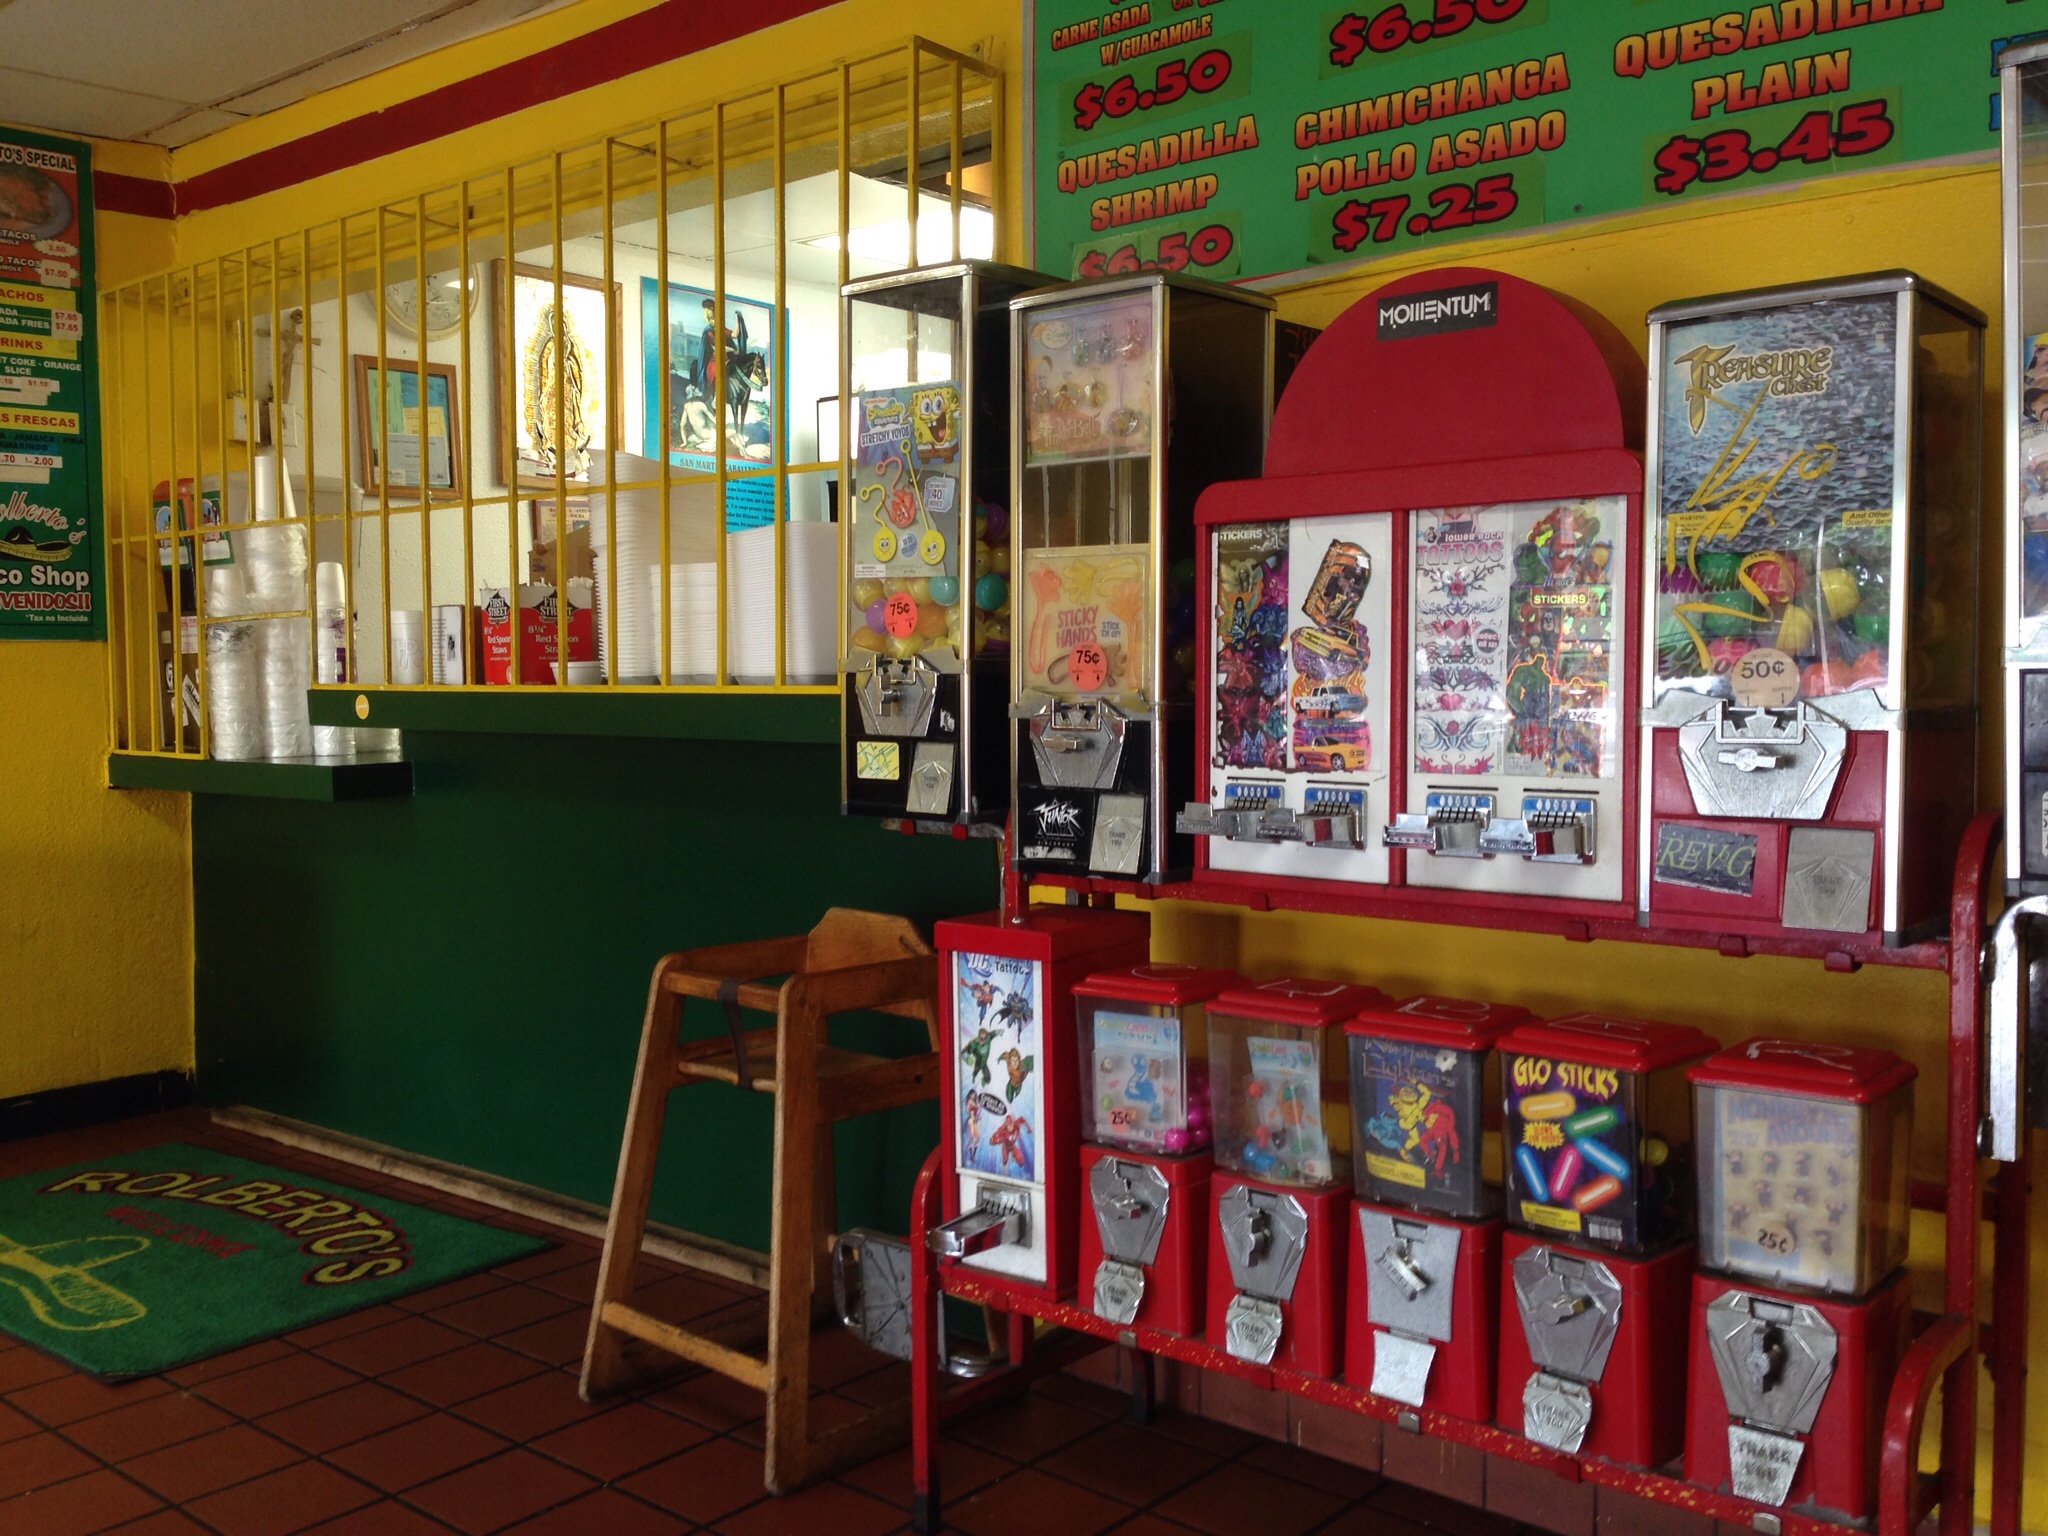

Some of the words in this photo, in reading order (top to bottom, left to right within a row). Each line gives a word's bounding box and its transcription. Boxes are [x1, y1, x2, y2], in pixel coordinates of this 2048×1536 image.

[1051, 17, 1099, 50] CARNE
[1101, 3, 1151, 37] ASADA
[1100, 14, 1213, 66] W/GUACAMOLE
[1074, 49, 1232, 131] $6.50
[1691, 48, 1851, 120] PLAIN
[1294, 52, 1571, 150] CHIMICHANGA
[1057, 114, 1259, 194] QUESADILLA
[1295, 142, 1417, 201] POLLO
[1426, 109, 1566, 174] ASADO
[1654, 99, 1894, 195] $3.45
[26, 151, 75, 170] SPECIAL
[1090, 173, 1218, 232] SHRIMP
[1332, 172, 1519, 253] $7.25
[2, 229, 37, 241] TACOS
[7, 256, 41, 268] TACOS
[21, 319, 50, 329] FRIES
[5, 366, 31, 375] SLICE
[10, 357, 36, 367] COKE
[43, 361, 82, 371] ORANGE
[14, 414, 76, 428] FRESCAS
[861, 430, 890, 446] STRETCHY
[680, 458, 694, 467] SAN
[696, 461, 716, 471] MART
[932, 489, 943, 500] 40
[1850, 511, 1867, 519] And
[1868, 511, 1890, 519] Other
[30, 564, 90, 591] Shop
[1534, 594, 1586, 605] STICKERS
[487, 606, 508, 617] STREET
[540, 606, 573, 617] STRT
[1058, 605, 1099, 629] STICKY
[535, 635, 552, 643] Red
[553, 635, 579, 644] Son
[1056, 626, 1097, 648] HANDS
[545, 645, 571, 654] Stras
[1076, 650, 1100, 666] 75¢
[1741, 660, 1785, 679] 50¢
[1513, 1056, 1551, 1087] GLO
[1557, 1062, 1619, 1100] STICKS
[42, 1170, 411, 1286] ROLBERTO'S
